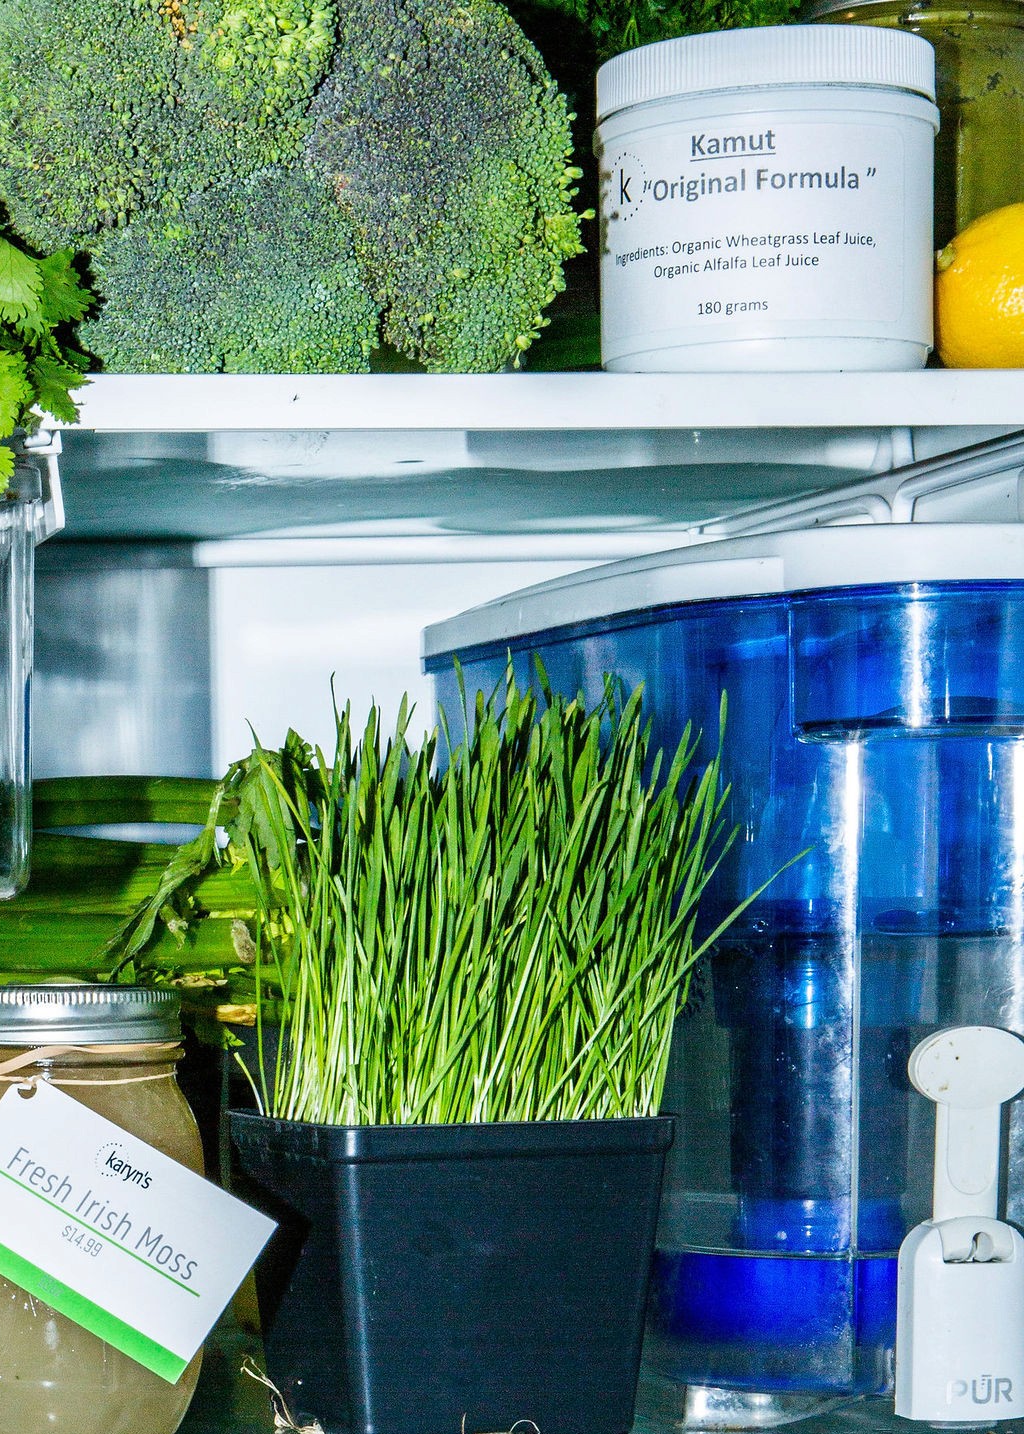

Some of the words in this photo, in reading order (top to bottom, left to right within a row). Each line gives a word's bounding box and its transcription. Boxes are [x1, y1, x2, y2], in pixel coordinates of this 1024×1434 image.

[691, 129, 776, 157] Kamut
[756, 166, 859, 192] Formula
[615, 244, 668, 266] Ingredients:
[672, 237, 722, 258] Organic
[726, 232, 808, 252] Wheatgrass
[814, 231, 840, 245] Leaf
[844, 232, 877, 249] Juice,
[653, 262, 700, 279] Organic
[703, 257, 748, 272] Alfalfa
[751, 254, 781, 269] Leaf
[785, 254, 819, 268] Juice
[697, 302, 721, 316] 180
[725, 300, 769, 317] grams
[105, 1151, 153, 1190] karyn's
[6, 1146, 73, 1203] Fresh
[75, 1189, 132, 1242] Irish
[135, 1225, 199, 1281] Moss
